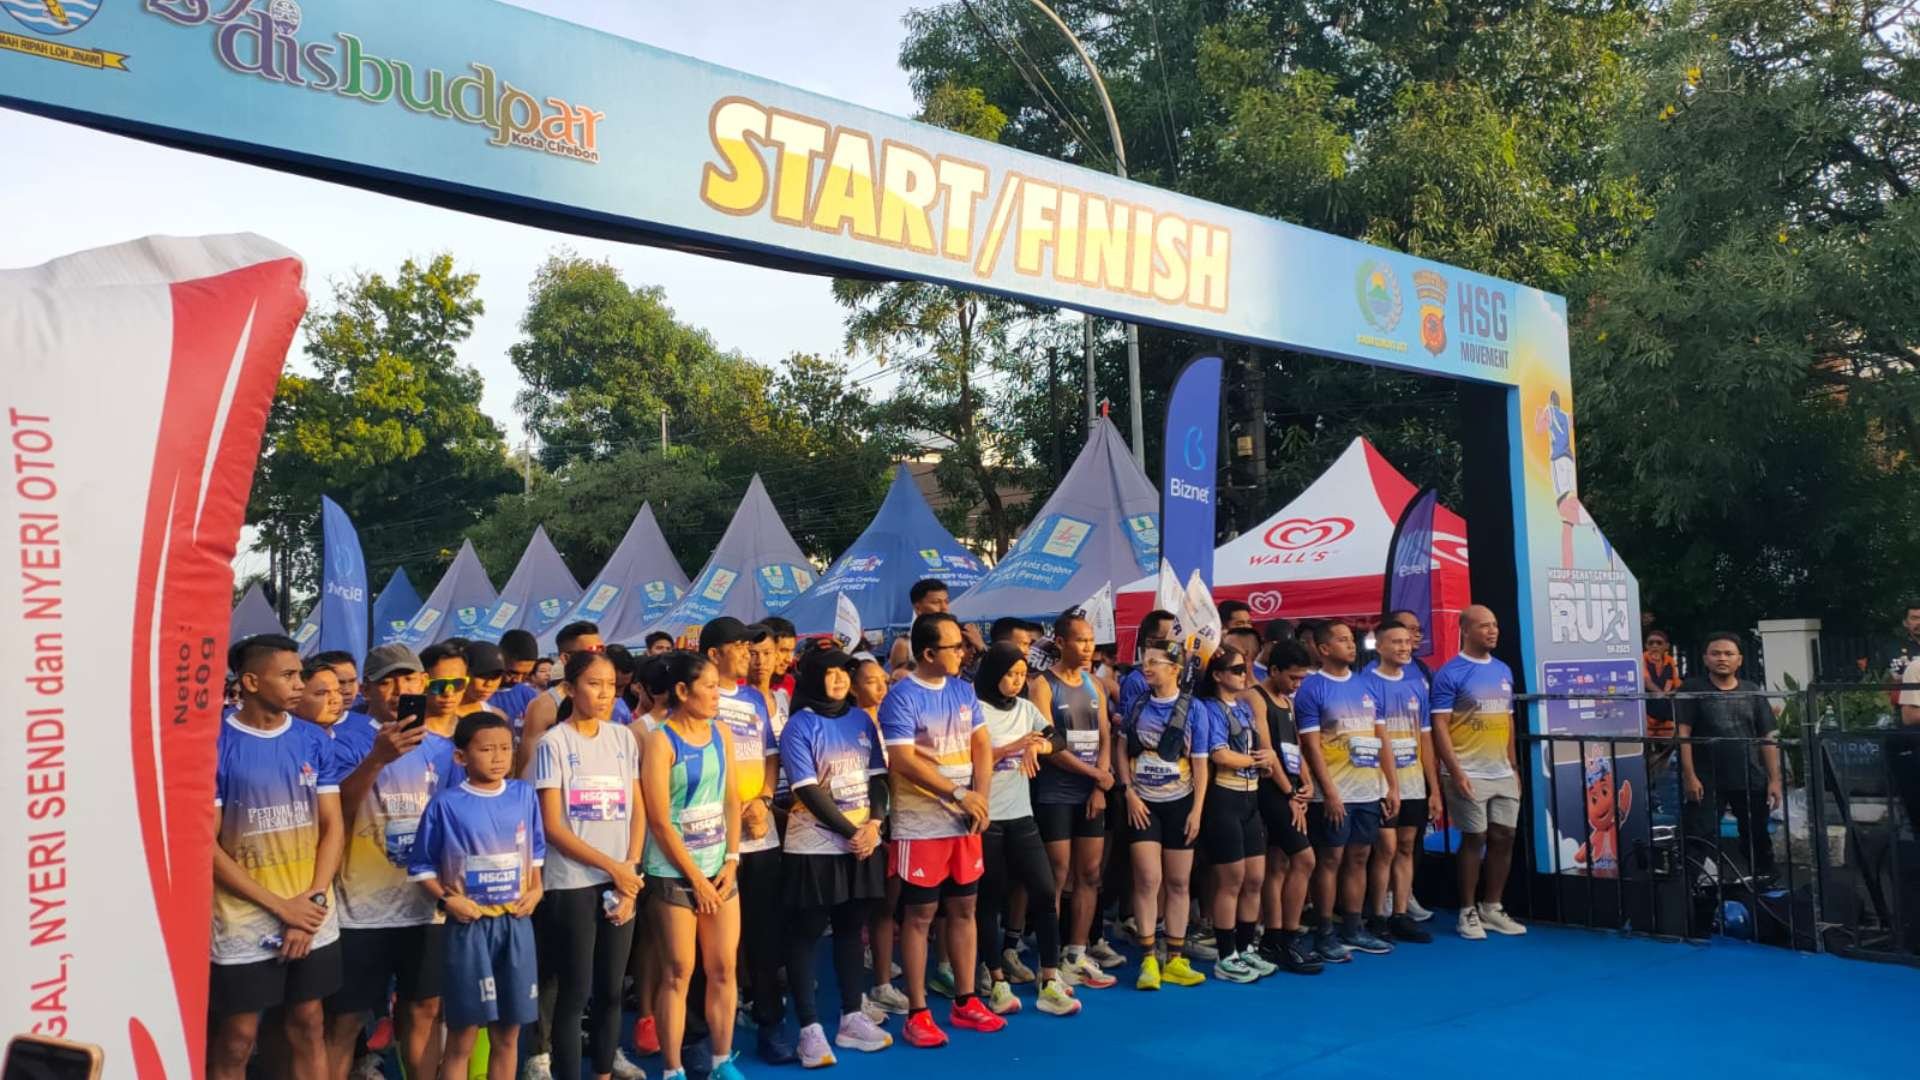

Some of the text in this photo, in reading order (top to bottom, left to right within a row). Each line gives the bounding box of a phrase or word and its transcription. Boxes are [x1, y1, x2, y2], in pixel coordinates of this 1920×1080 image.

[20, 39, 48, 54] RIPAH
[49, 45, 69, 58] LOH
[217, 6, 604, 146] disbudpar
[511, 131, 598, 161] Kota Cirebon
[1457, 281, 1508, 342] HSG
[1460, 341, 1509, 370] MOVEMENT
[9, 407, 57, 502] OTOT
[1170, 478, 1209, 504] Biznet
[19, 513, 62, 619] NYERI
[1249, 550, 1327, 566] WALL'S
[1549, 581, 1629, 642] RUN
[25, 633, 64, 696] dan
[174, 643, 191, 725] Netto
[195, 637, 215, 709] 60g
[26, 708, 66, 820] SENDI
[28, 831, 67, 947] NYERI
